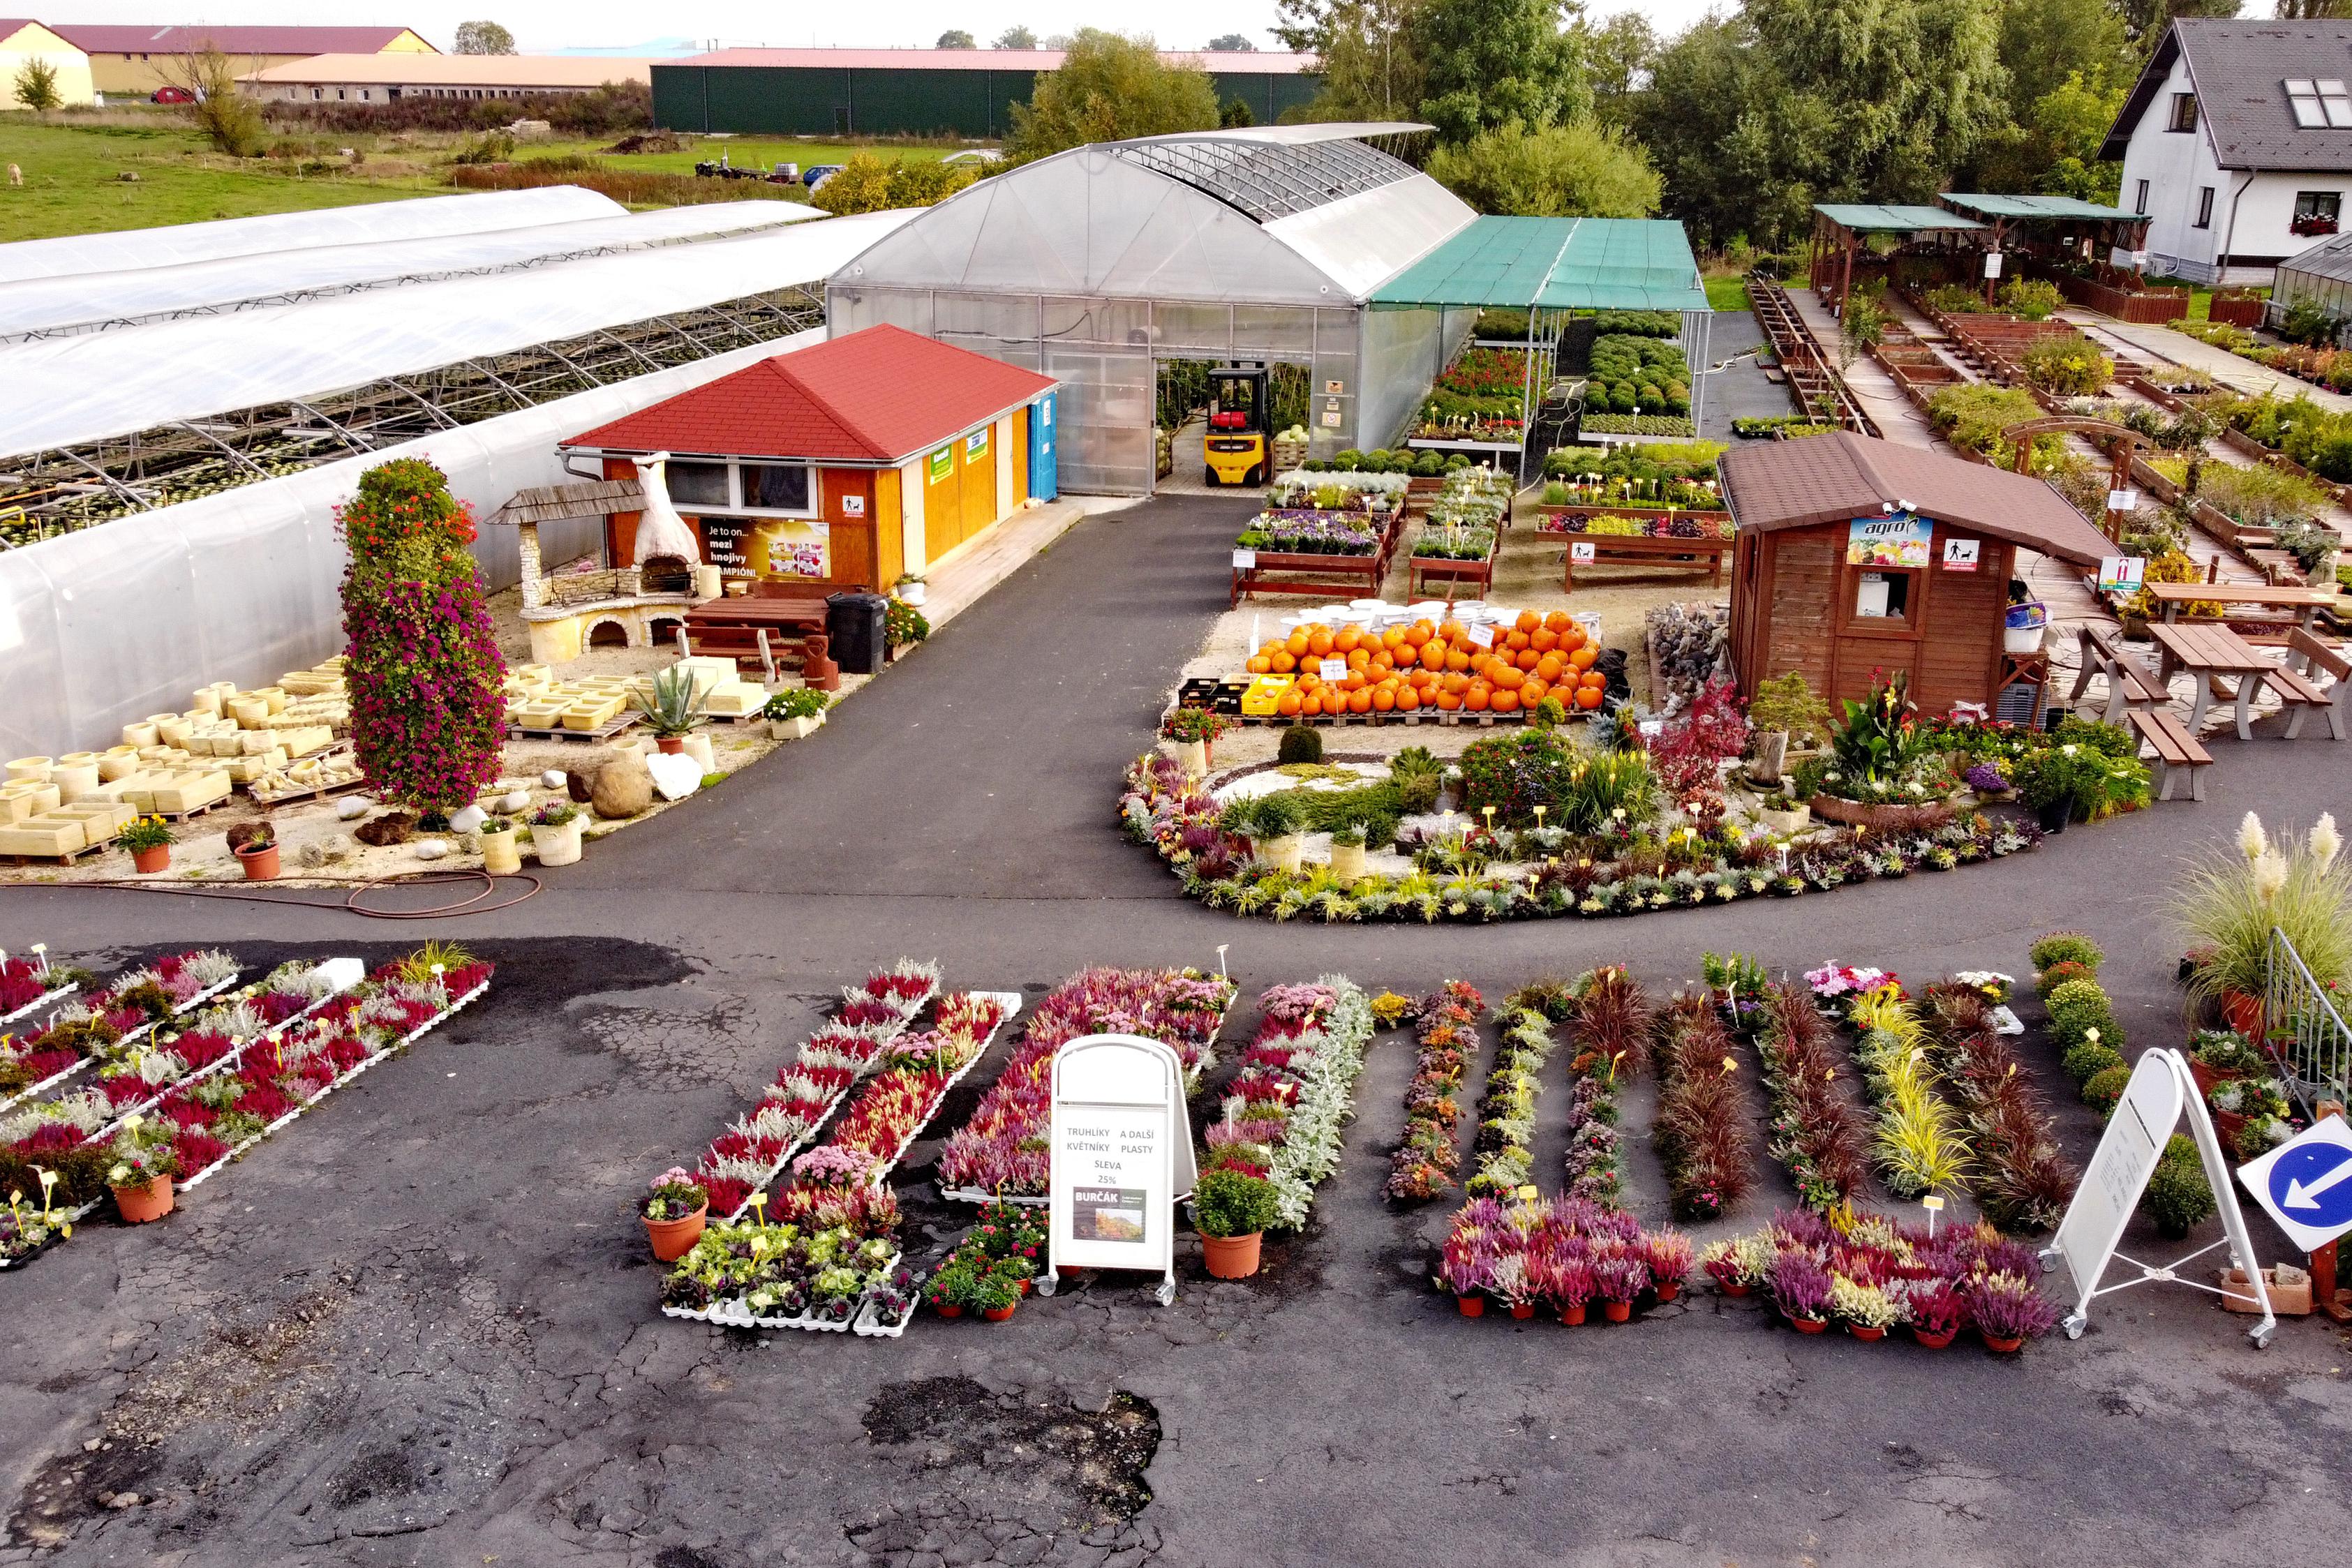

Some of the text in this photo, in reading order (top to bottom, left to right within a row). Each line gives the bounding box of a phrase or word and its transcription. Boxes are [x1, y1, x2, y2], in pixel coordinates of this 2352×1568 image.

[709, 526, 749, 537] Je to on...
[1864, 521, 1905, 535] agro
[710, 539, 732, 548] mezi
[710, 552, 746, 565] hnojivy
[1067, 1128, 1110, 1137] TRUHLÍKY
[1129, 1129, 1154, 1139] DALŠÍ
[1067, 1141, 1154, 1153] KVĚTNÍKY PLASTY
[1094, 1160, 1122, 1170] SLEVA
[1098, 1175, 1117, 1184] 25%
[1075, 1190, 1118, 1203] BURČÁK
